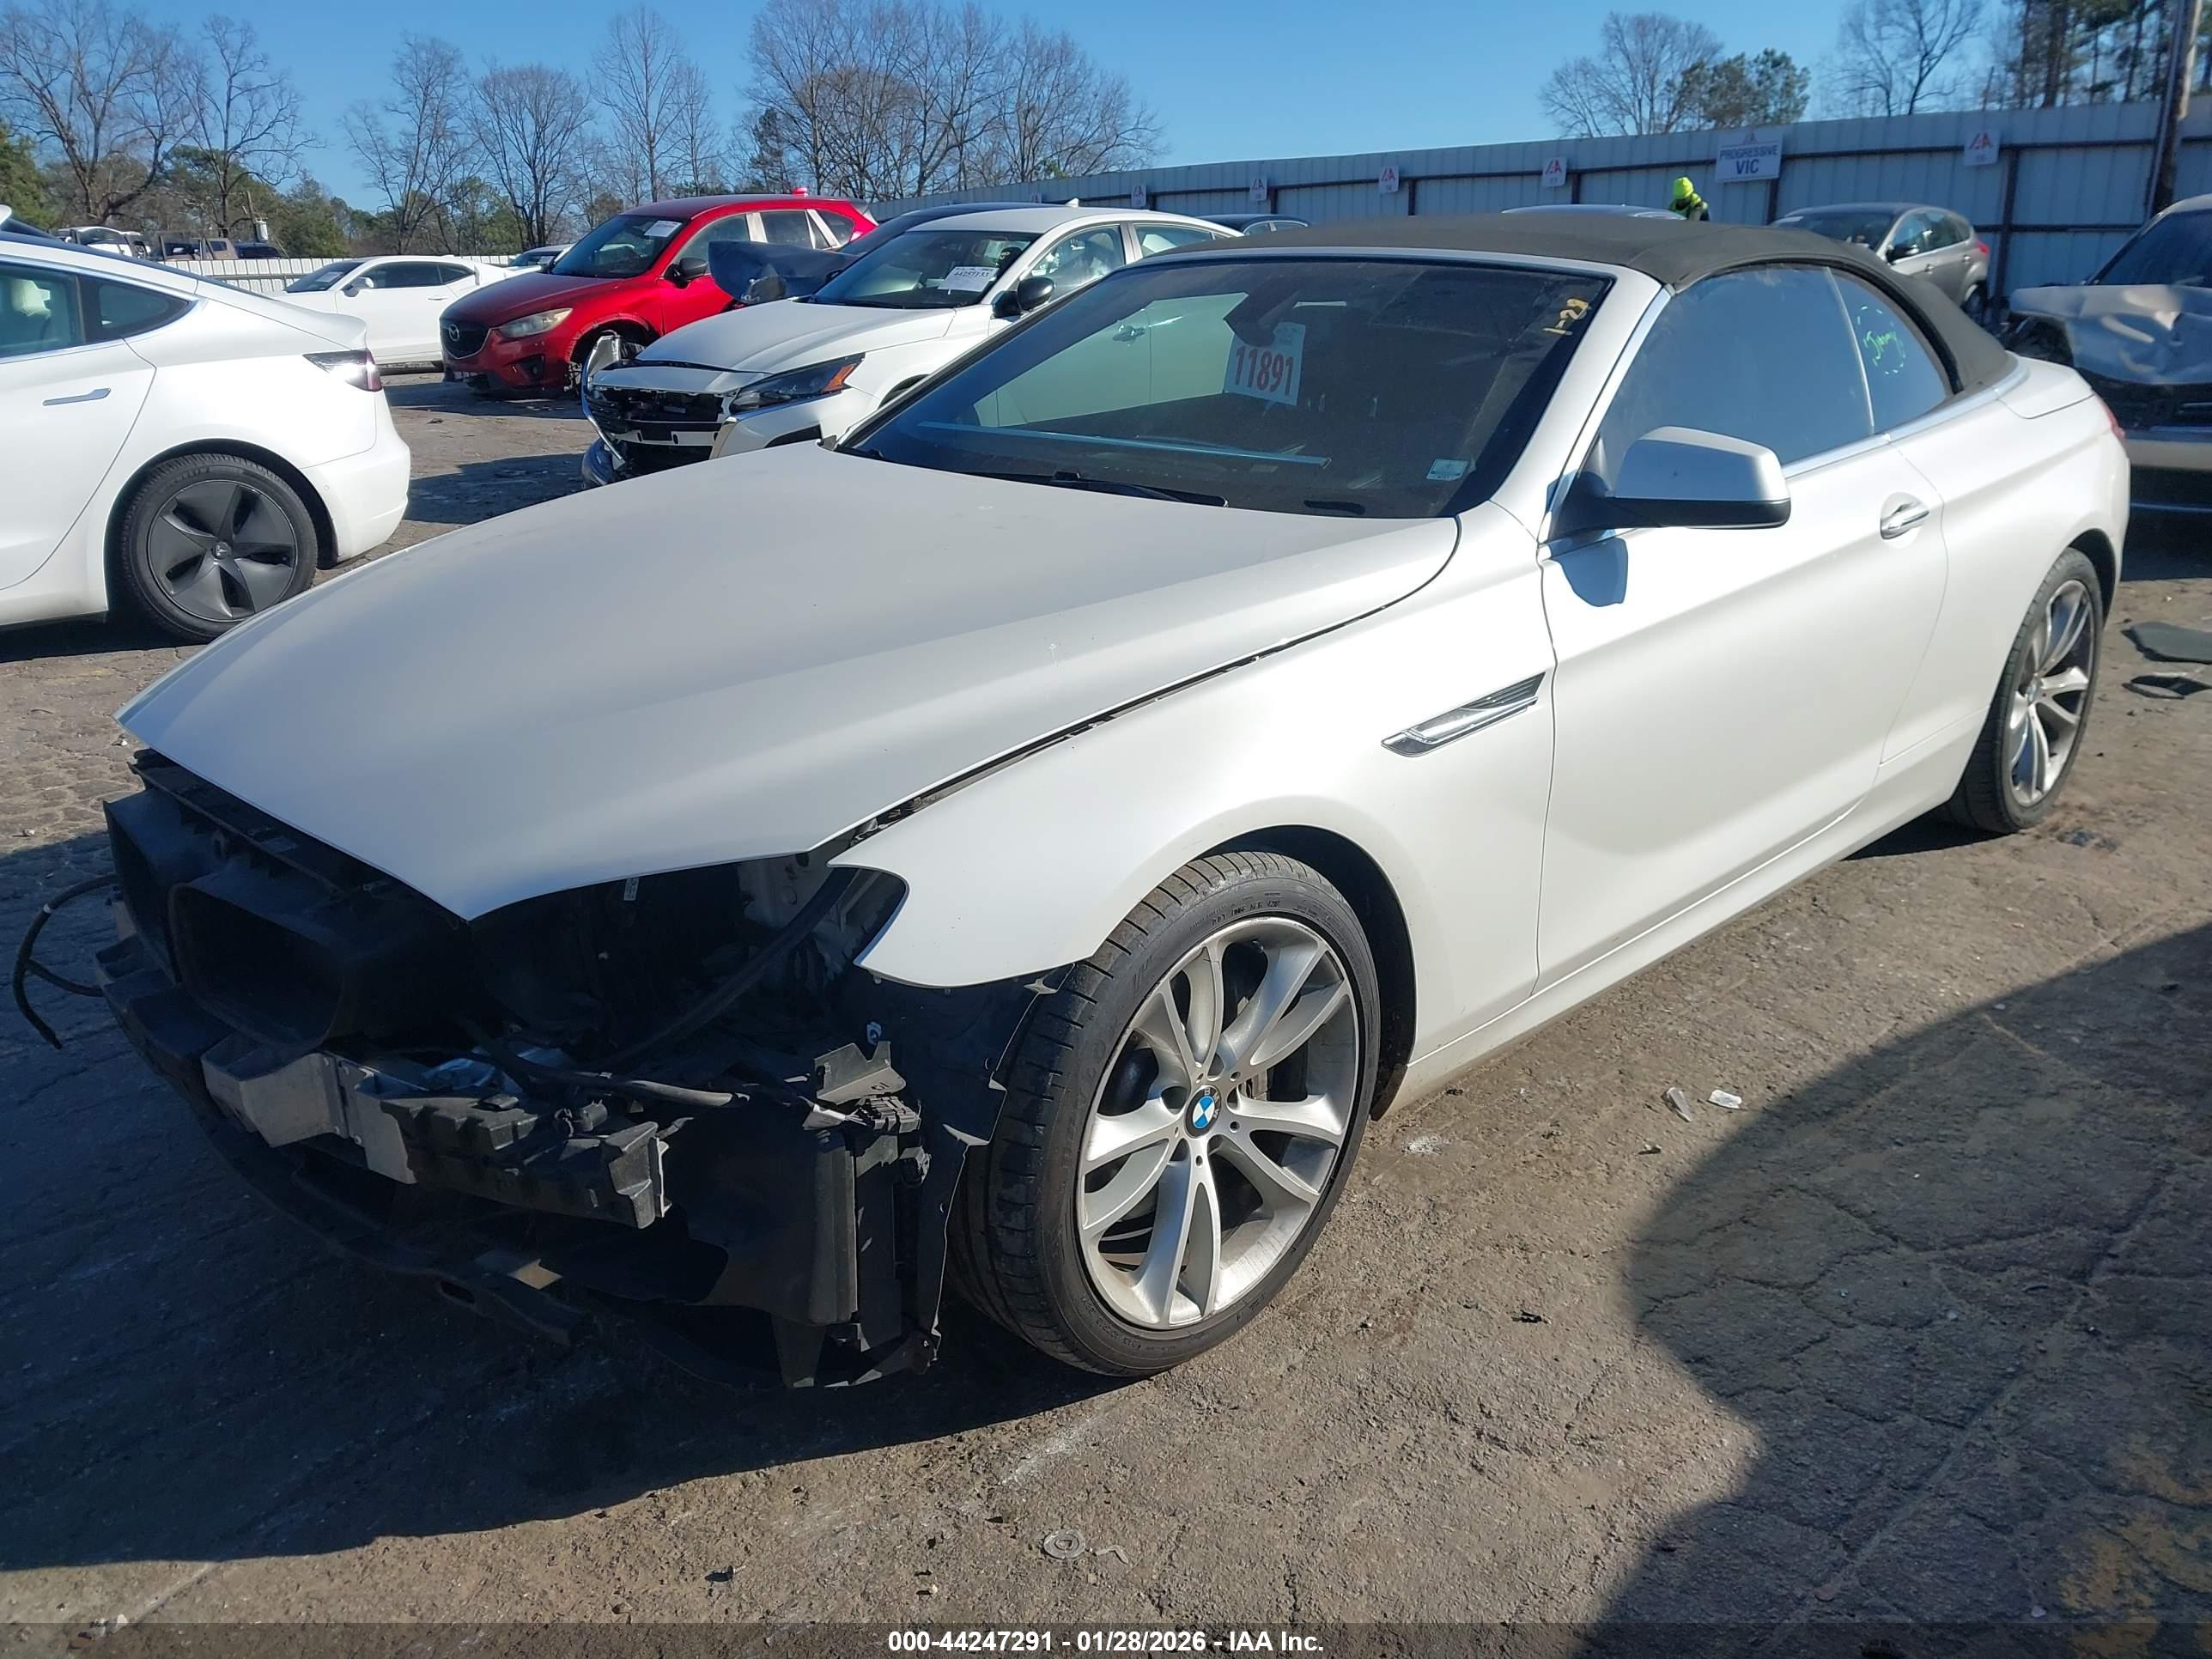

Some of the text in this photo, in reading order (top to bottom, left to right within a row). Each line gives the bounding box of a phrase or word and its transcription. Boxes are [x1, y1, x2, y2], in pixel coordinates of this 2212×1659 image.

[1719, 144, 1779, 161] PROGRESSIVE
[1735, 159, 1759, 174] VIC
[1235, 345, 1294, 396] 11891
